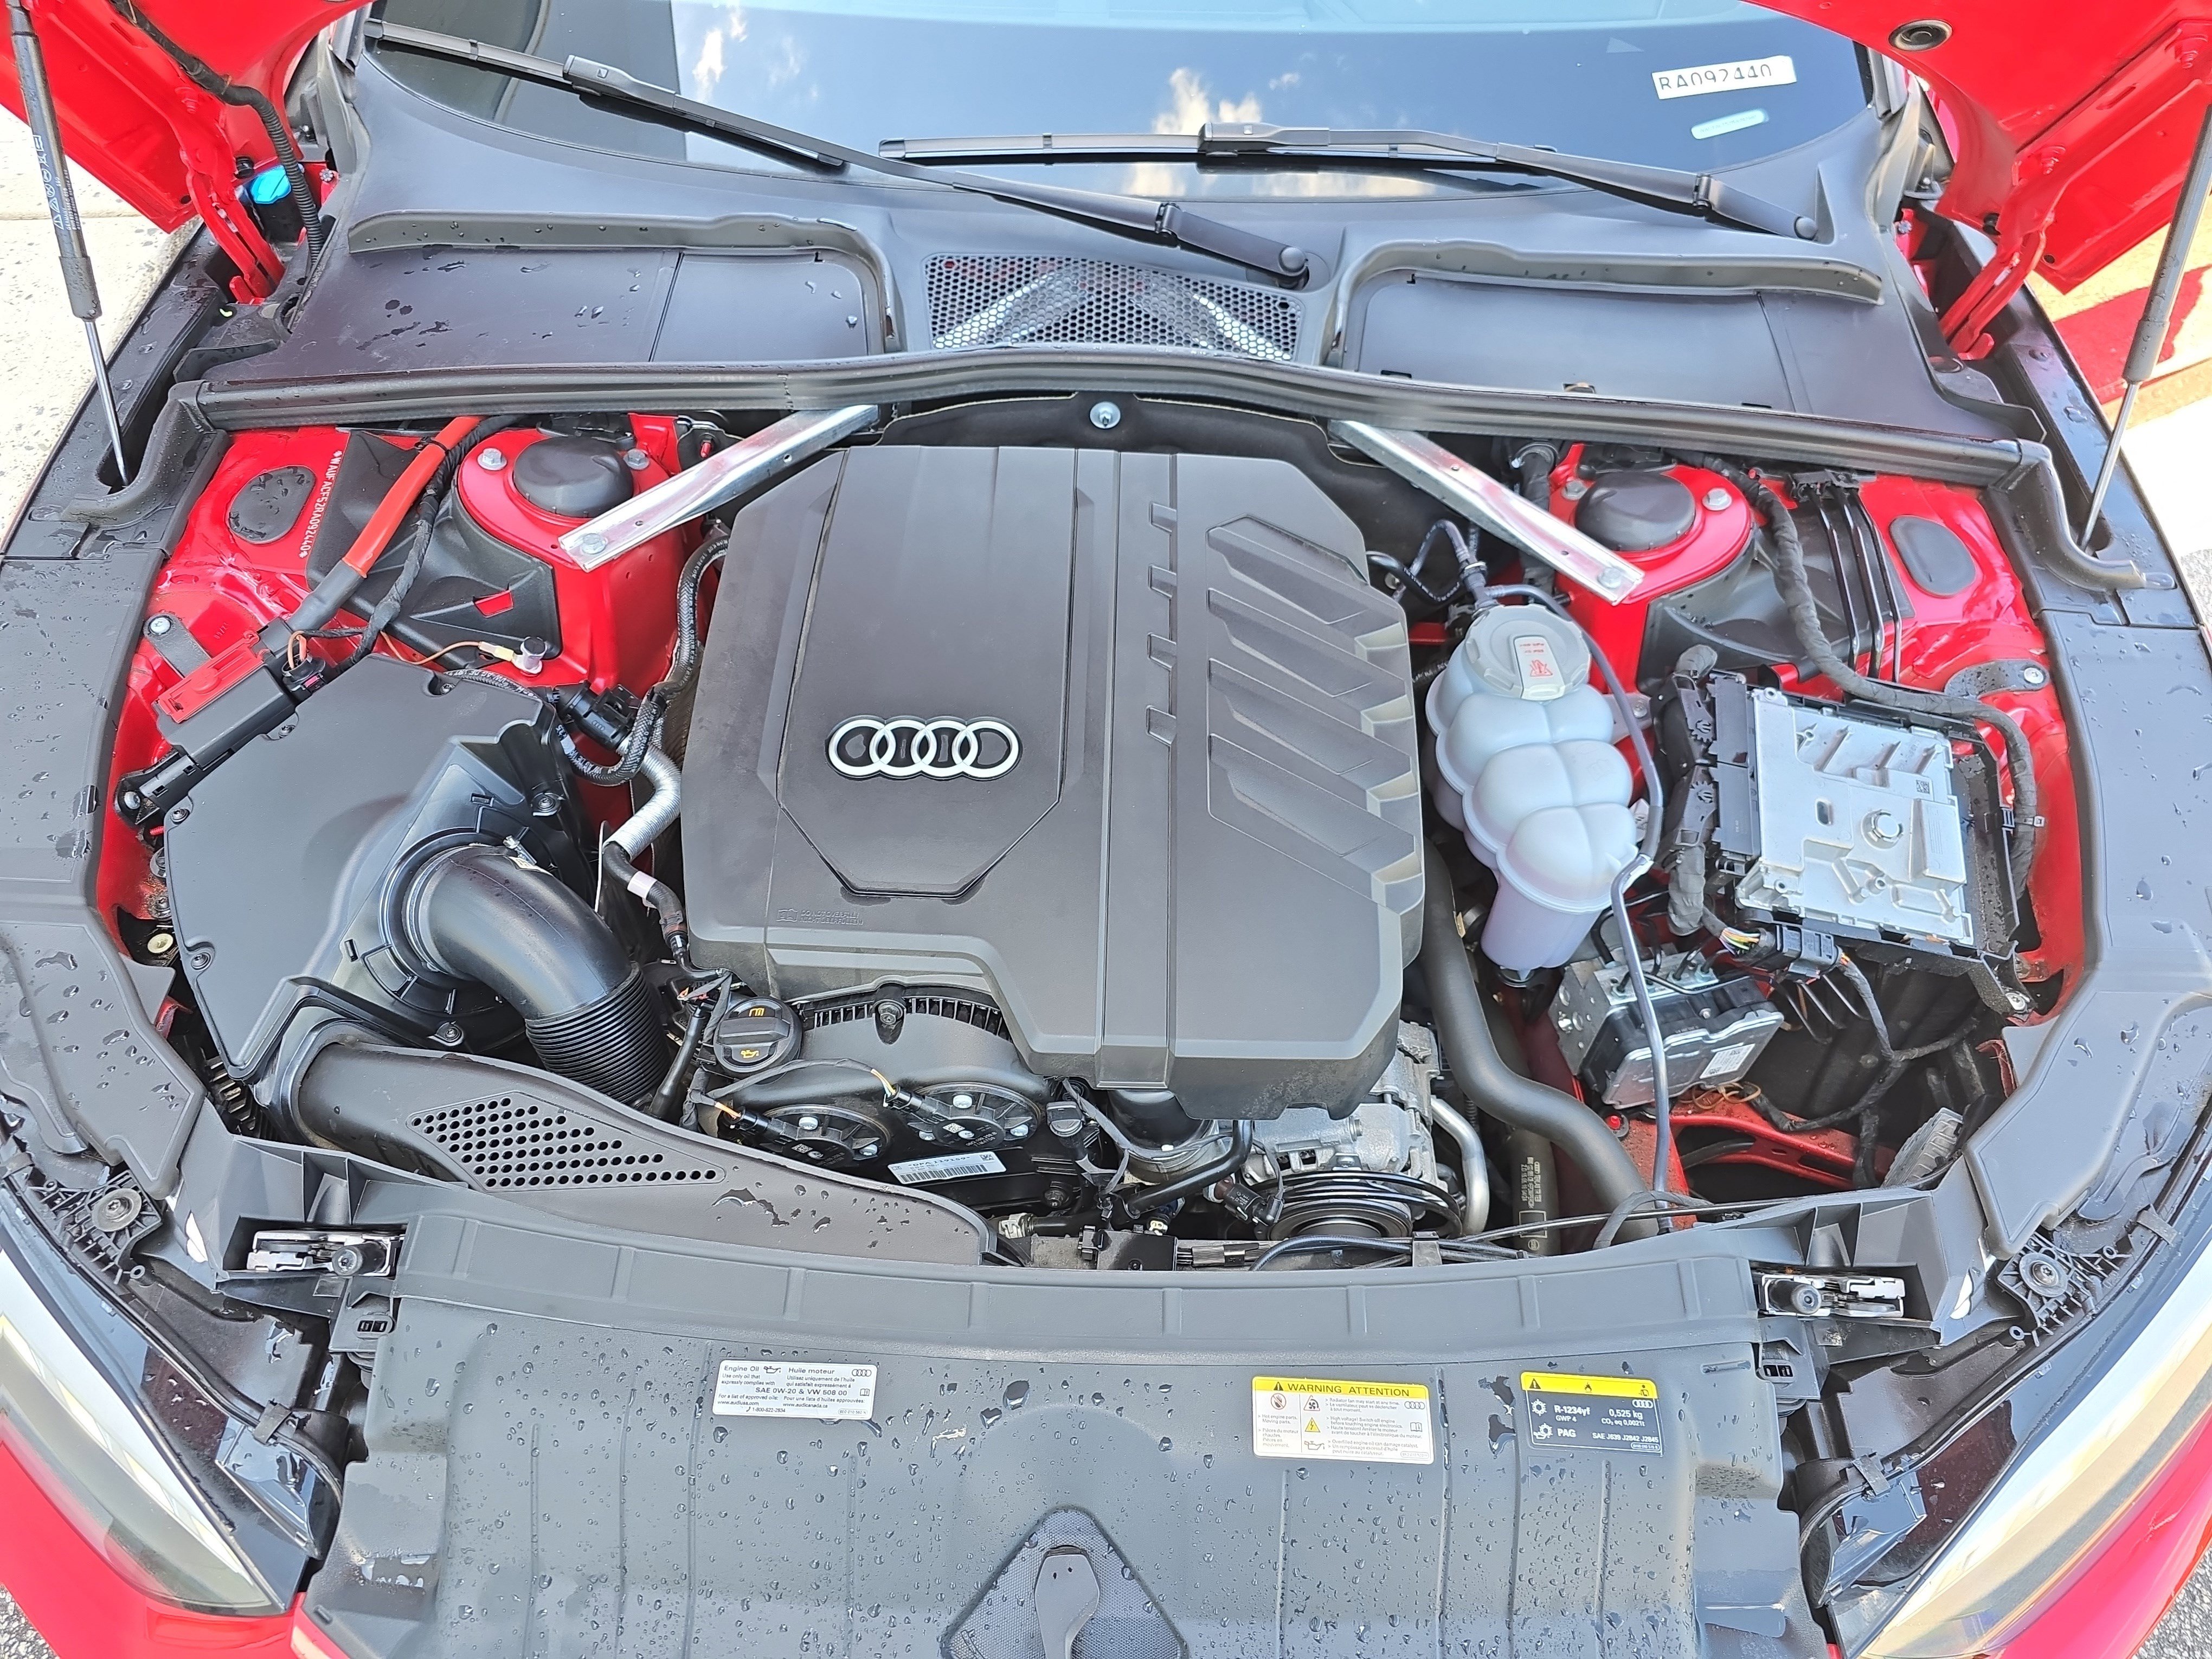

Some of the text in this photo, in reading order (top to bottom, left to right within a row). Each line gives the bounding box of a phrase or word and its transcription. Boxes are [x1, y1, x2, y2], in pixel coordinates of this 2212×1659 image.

[1288, 1383, 1410, 1397] WARNING ATTENTION
[1554, 1405, 1590, 1416] R-1234yf
[1609, 1409, 1643, 1419] 0,525 kg
[1557, 1429, 1576, 1437] PAG
